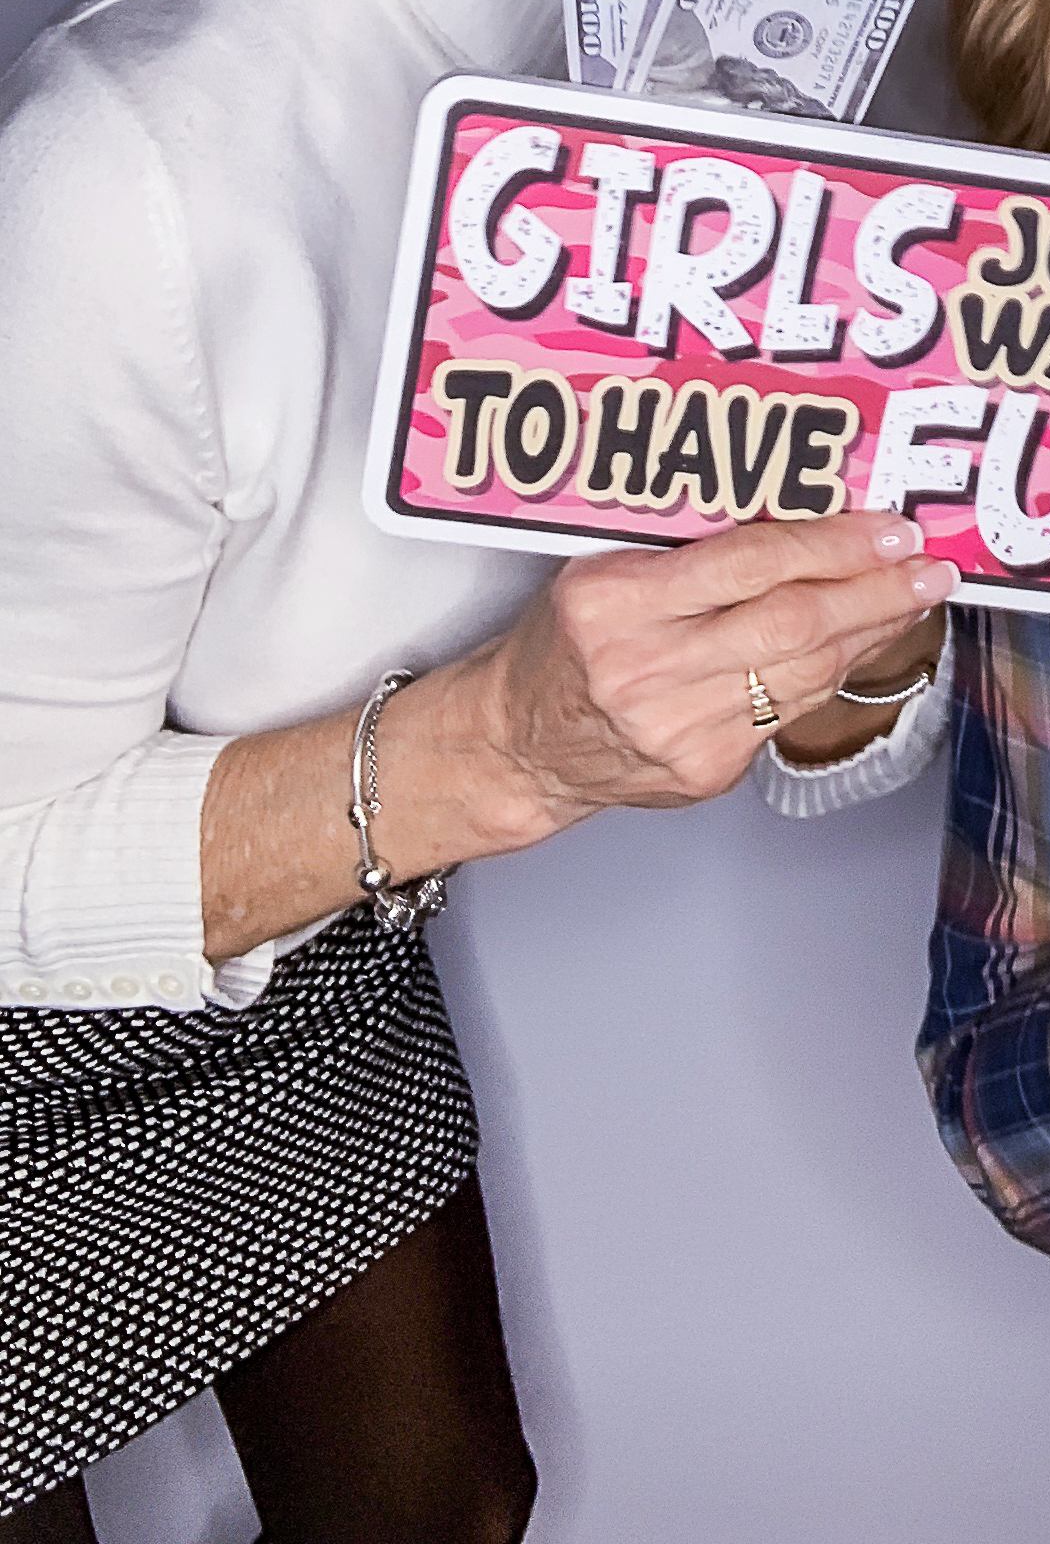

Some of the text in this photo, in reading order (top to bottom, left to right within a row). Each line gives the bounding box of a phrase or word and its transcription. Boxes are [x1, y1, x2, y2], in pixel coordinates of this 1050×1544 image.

[580, 1, 602, 56] 100
[448, 125, 958, 360] GIRLS
[443, 368, 568, 485] TO
[585, 376, 850, 515] HAVE
